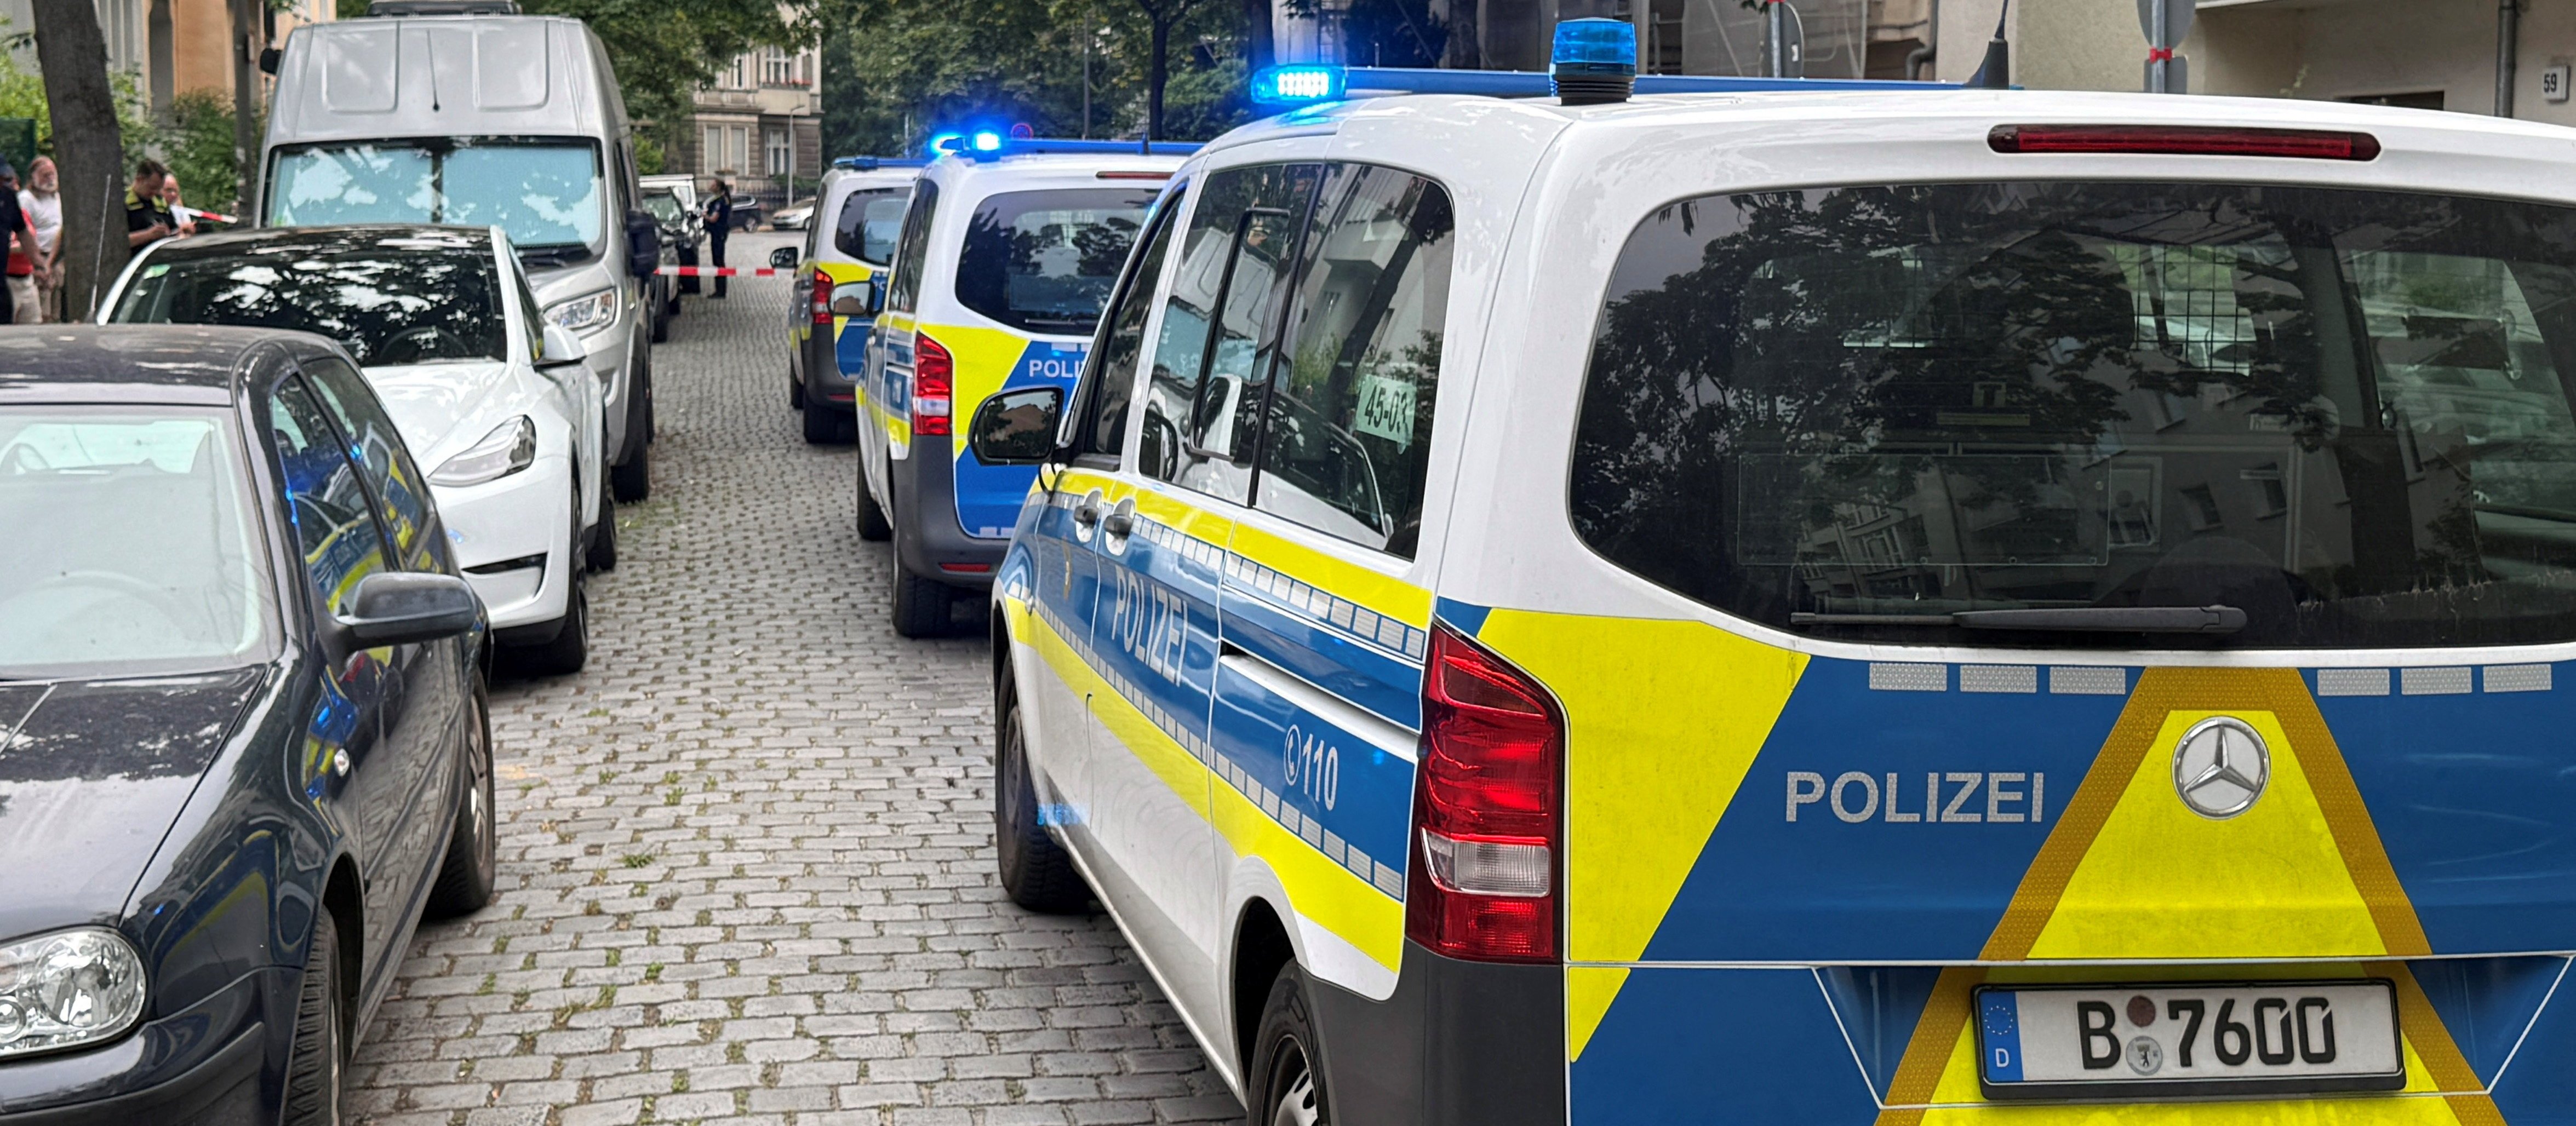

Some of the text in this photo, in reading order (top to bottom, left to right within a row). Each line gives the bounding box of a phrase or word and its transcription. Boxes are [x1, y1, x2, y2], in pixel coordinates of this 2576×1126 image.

[2544, 73, 2557, 93] 59
[1029, 359, 1084, 378] POLI
[1112, 565, 1188, 687] POLIZEI
[1302, 733, 1338, 811] 110
[1786, 771, 2044, 823] POLIZEI
[1995, 1048, 2010, 1067] D
[2077, 997, 2336, 1070] B 7600
